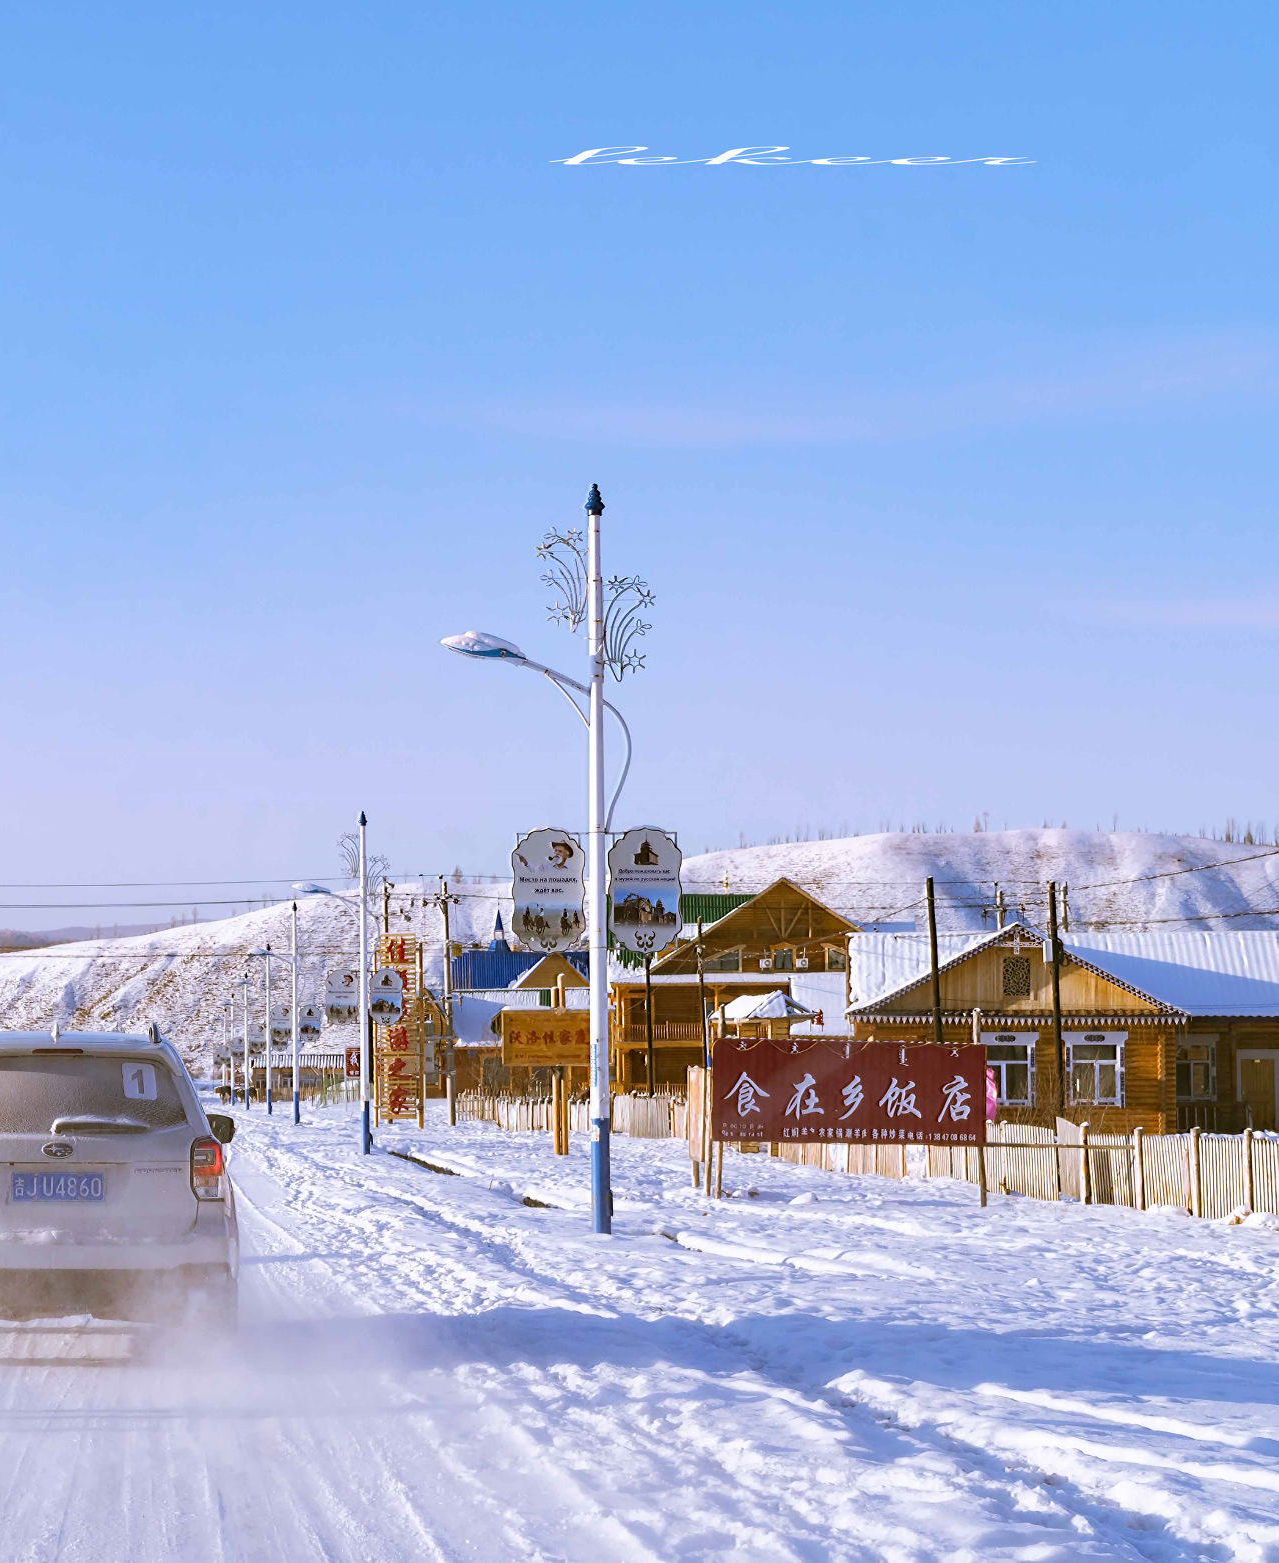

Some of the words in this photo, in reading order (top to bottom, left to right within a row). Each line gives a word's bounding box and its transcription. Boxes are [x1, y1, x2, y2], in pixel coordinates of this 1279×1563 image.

[131, 1069, 145, 1095] 1
[723, 1071, 972, 1123] 食在乡饭店
